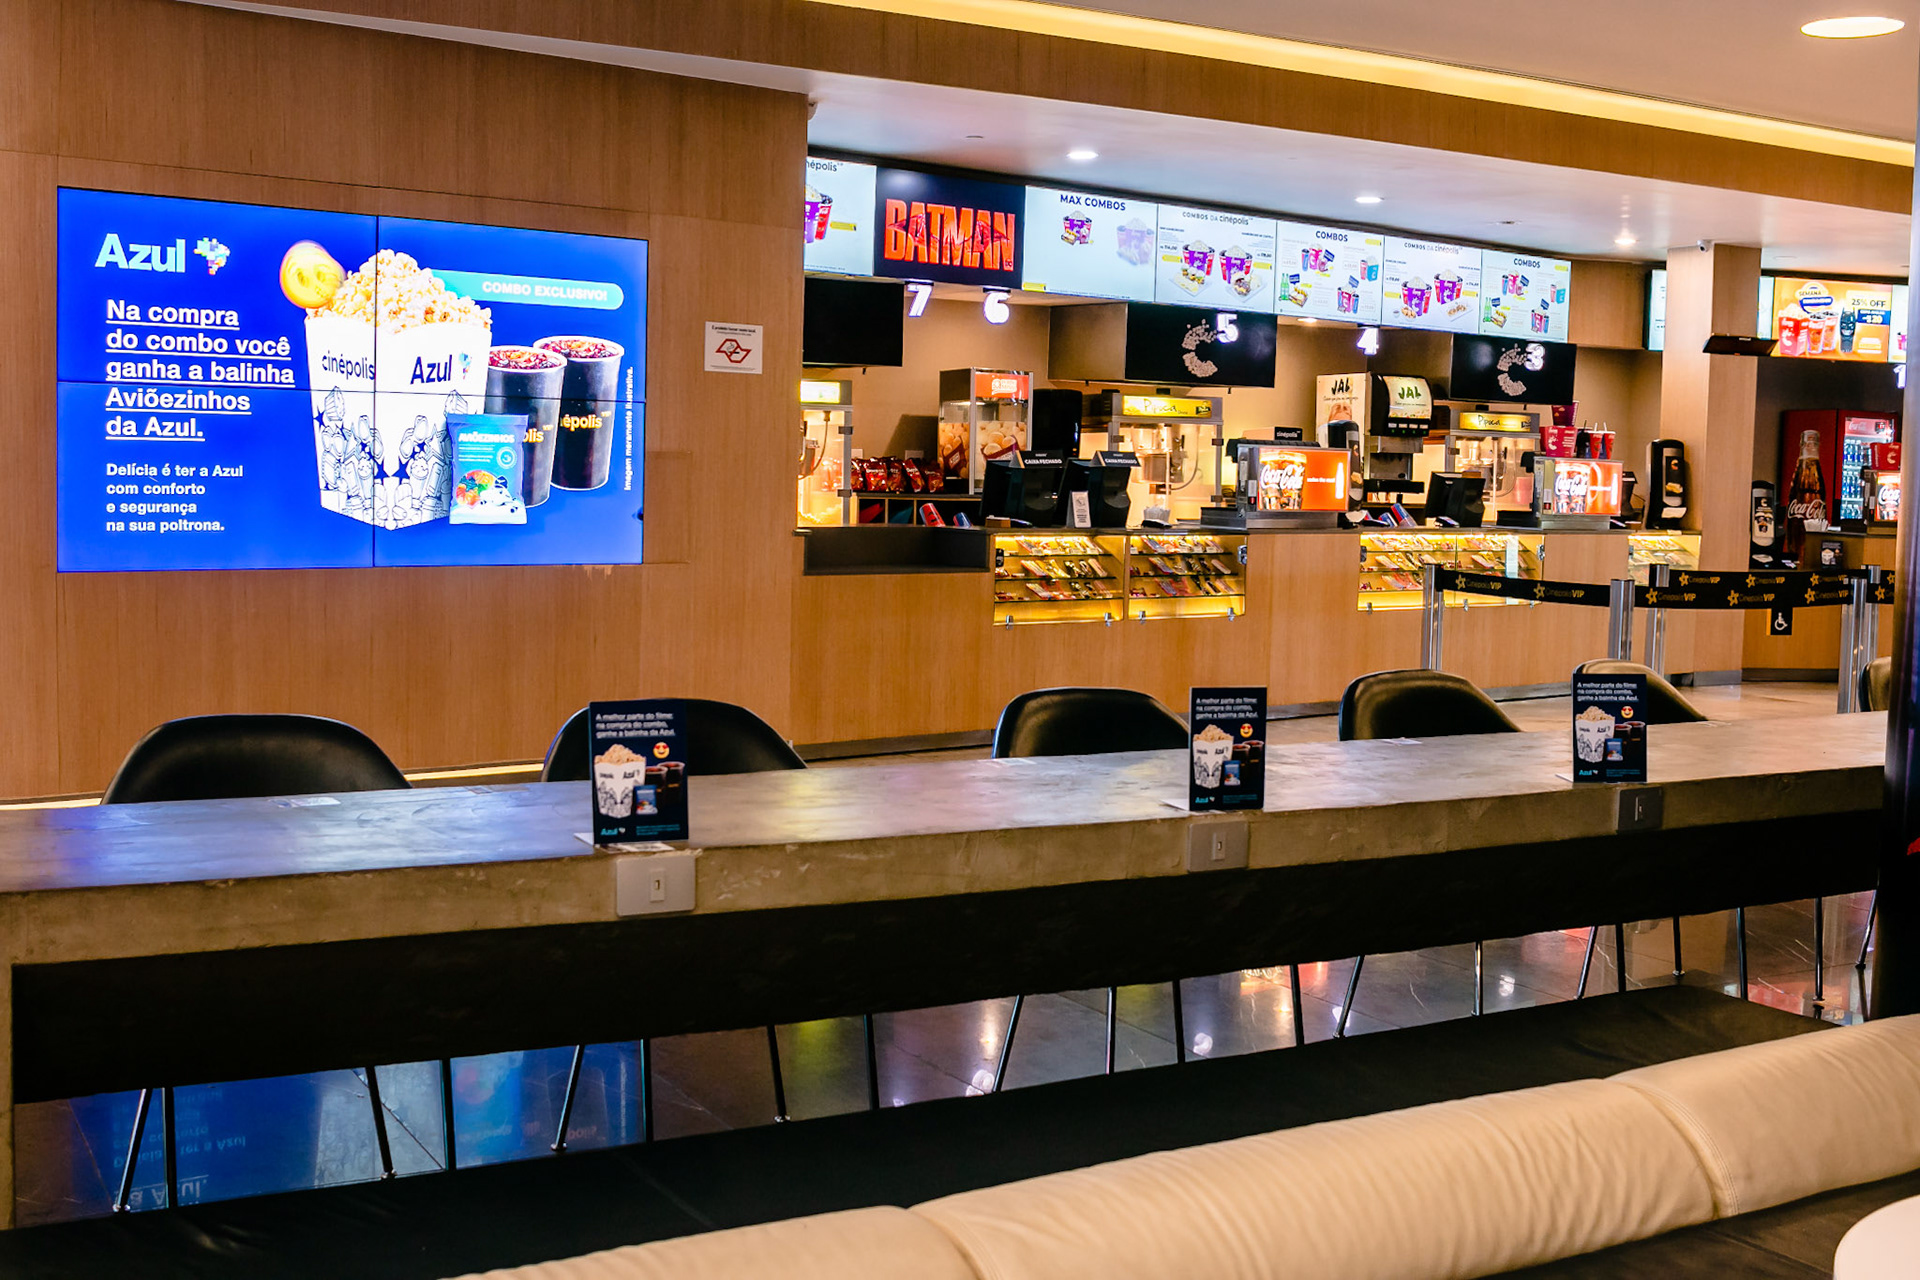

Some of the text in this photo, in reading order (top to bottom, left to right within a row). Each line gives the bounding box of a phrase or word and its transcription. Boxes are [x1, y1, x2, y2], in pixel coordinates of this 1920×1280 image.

[1060, 194, 1126, 211] MAX COMBOS
[1182, 211, 1209, 221] COMBOS
[884, 199, 1015, 271] BATMAN
[1316, 230, 1348, 242] COMBOS
[95, 233, 186, 273] Azul
[1404, 242, 1426, 250] COMBOS
[1513, 258, 1541, 269] COMBOS
[482, 281, 608, 301] COMBO EXCLUSIVO!
[907, 284, 933, 317] 7
[106, 299, 239, 327] Na compra
[983, 292, 1010, 325] 6
[1870, 299, 1887, 308] OFF
[1216, 313, 1239, 344] 5
[106, 329, 291, 356] do combo você
[1357, 327, 1380, 356] 4
[321, 349, 376, 381] cinépolis
[1525, 343, 1547, 371] 3
[106, 359, 295, 384] ganha a balinha
[410, 354, 453, 385] Azul
[1893, 364, 1907, 389] 1
[1331, 377, 1350, 395] JAL
[1398, 386, 1422, 399] JAL
[106, 387, 250, 410] Aviõezinhos
[106, 416, 203, 437] da Azul.
[106, 463, 243, 477] Delícia é ter a Azul
[1260, 464, 1305, 490] Coca-Cola
[106, 482, 206, 495] com conforto
[106, 502, 197, 516] e segurança
[1788, 498, 1826, 520] Coca-Cola
[106, 519, 225, 534] na sua poltrona.
[1490, 582, 1502, 590] VIP
[1571, 590, 1585, 598] VIP
[1838, 590, 1849, 598] VIP
[1684, 593, 1697, 601] VIP
[1763, 593, 1775, 601] VIP
